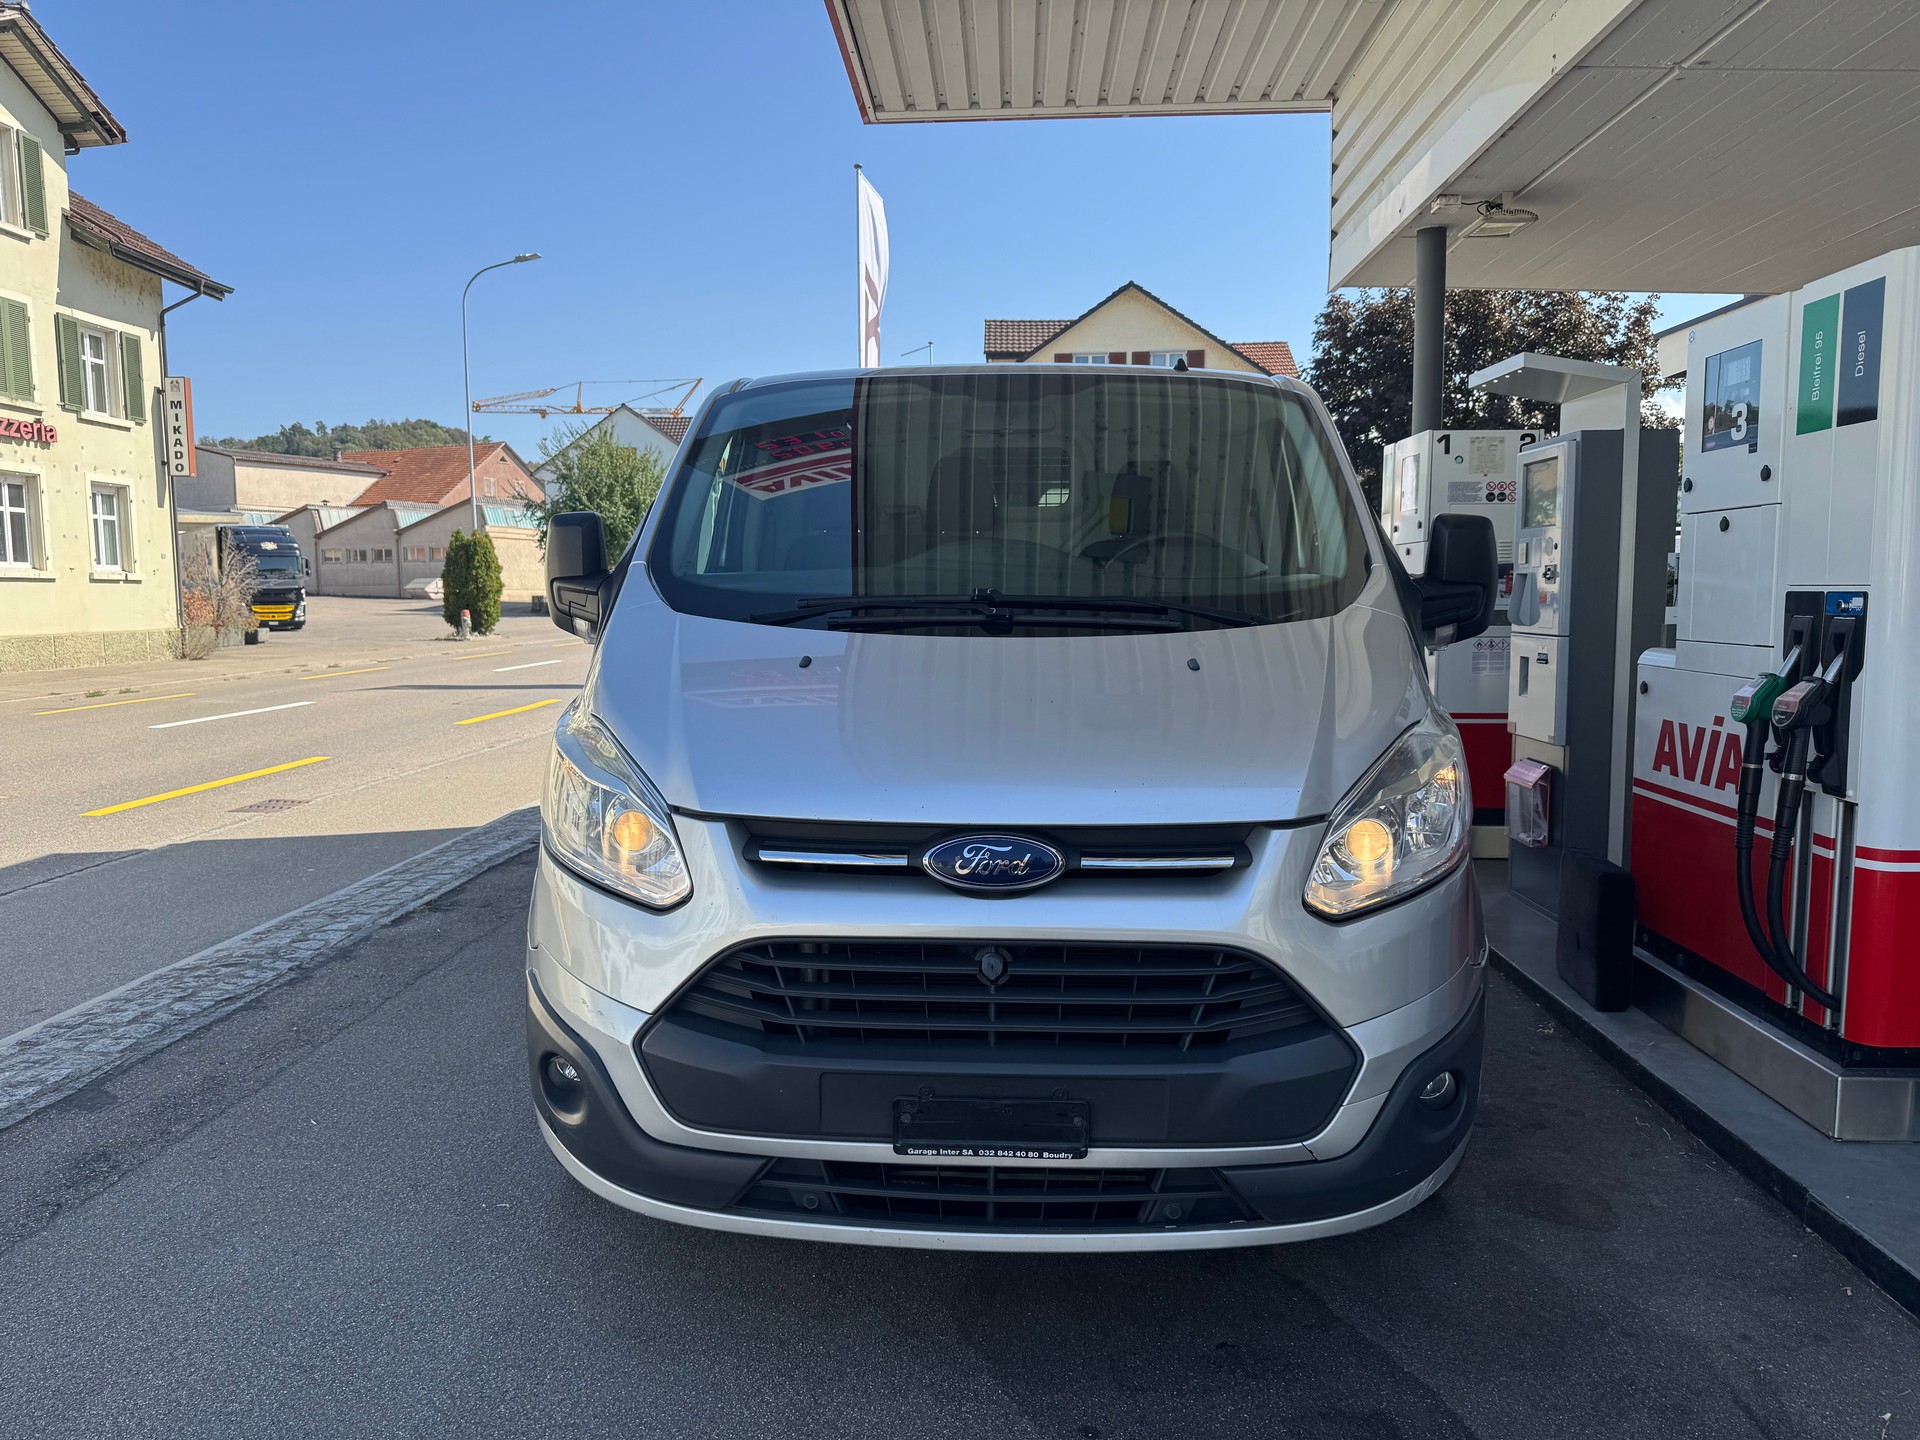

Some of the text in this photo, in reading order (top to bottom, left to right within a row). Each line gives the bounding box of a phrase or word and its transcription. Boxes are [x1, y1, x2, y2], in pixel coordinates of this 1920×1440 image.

[1811, 331, 1823, 401] Bleifrei 95
[1855, 330, 1866, 377] Diesel
[170, 400, 184, 472] MIKADO
[1730, 402, 1748, 441] 3
[1436, 434, 1451, 455] 1
[1519, 433, 1536, 453] 2
[954, 843, 1031, 876] Ford
[907, 1147, 938, 1156] Garage
[939, 1148, 960, 1156] Inter
[1015, 1150, 1026, 1158] 40
[1042, 1151, 1073, 1160] Boudry
